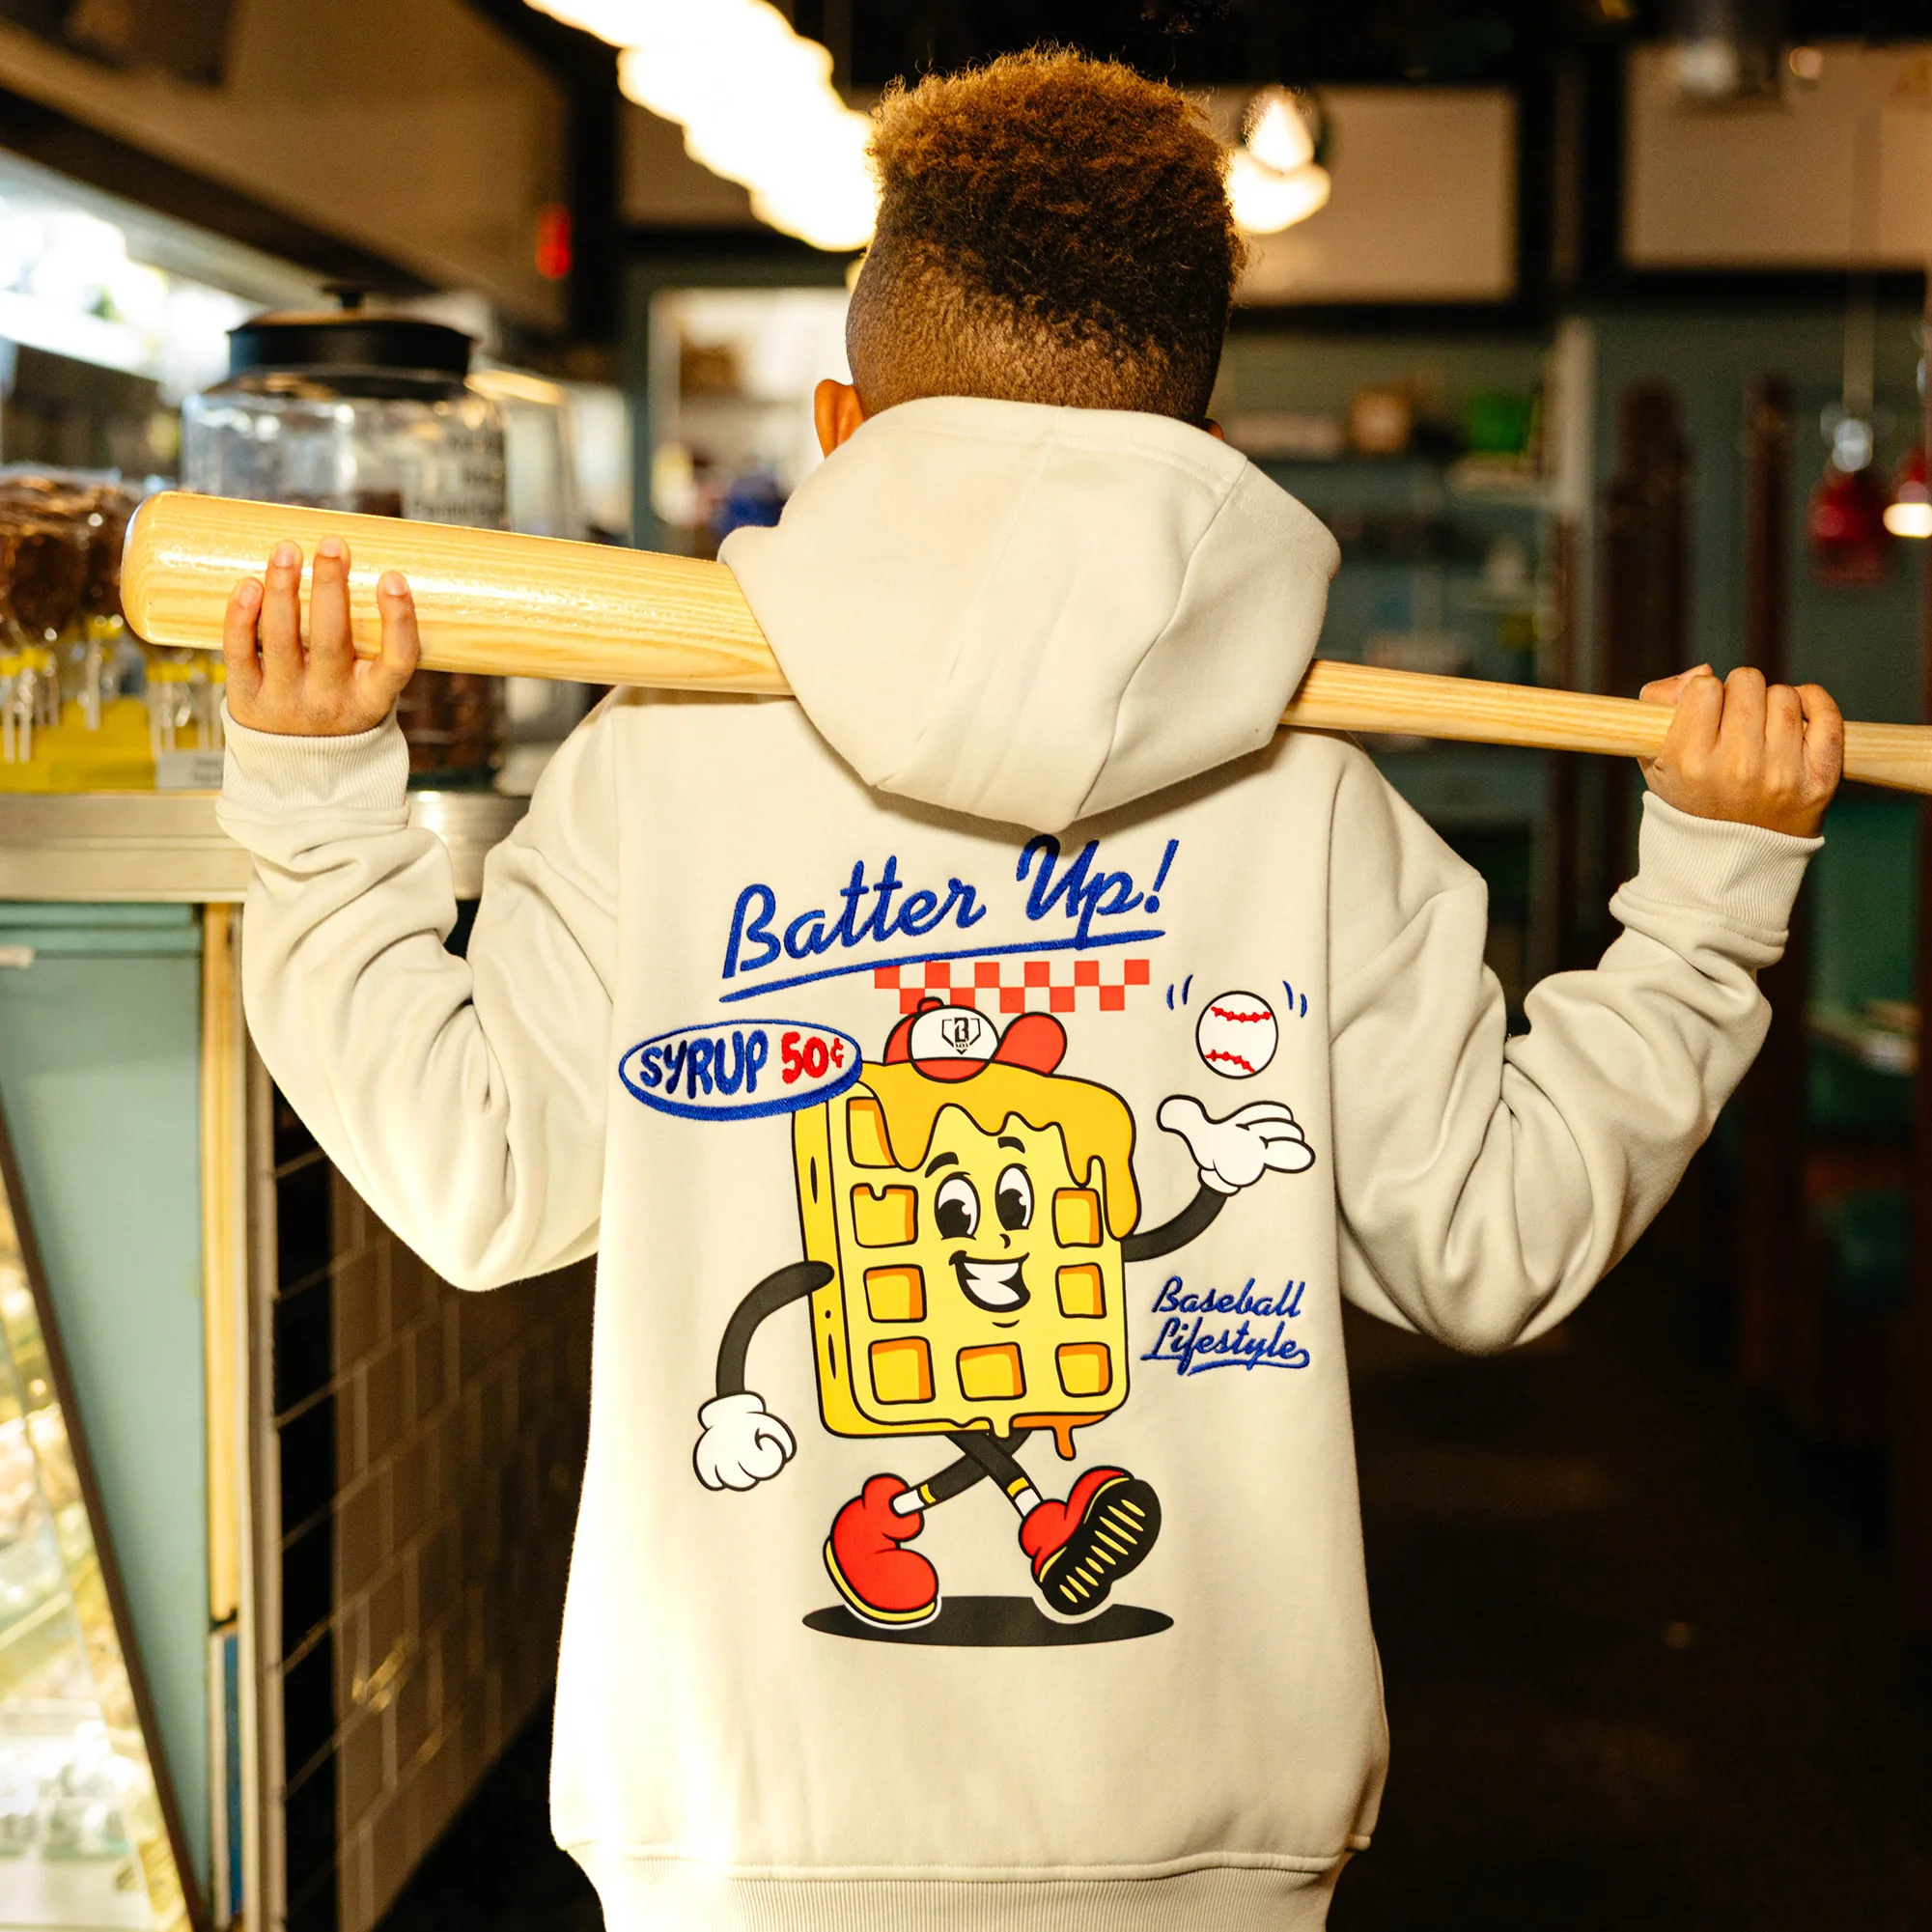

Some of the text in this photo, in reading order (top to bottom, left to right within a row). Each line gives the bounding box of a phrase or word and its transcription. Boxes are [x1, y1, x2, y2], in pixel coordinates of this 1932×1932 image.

[722, 834, 1180, 979] Batter Up!
[640, 1029, 845, 1099] SYRUP 50¢
[1151, 1275, 1305, 1318] Baseball
[1140, 1317, 1310, 1376] Lifestyle
